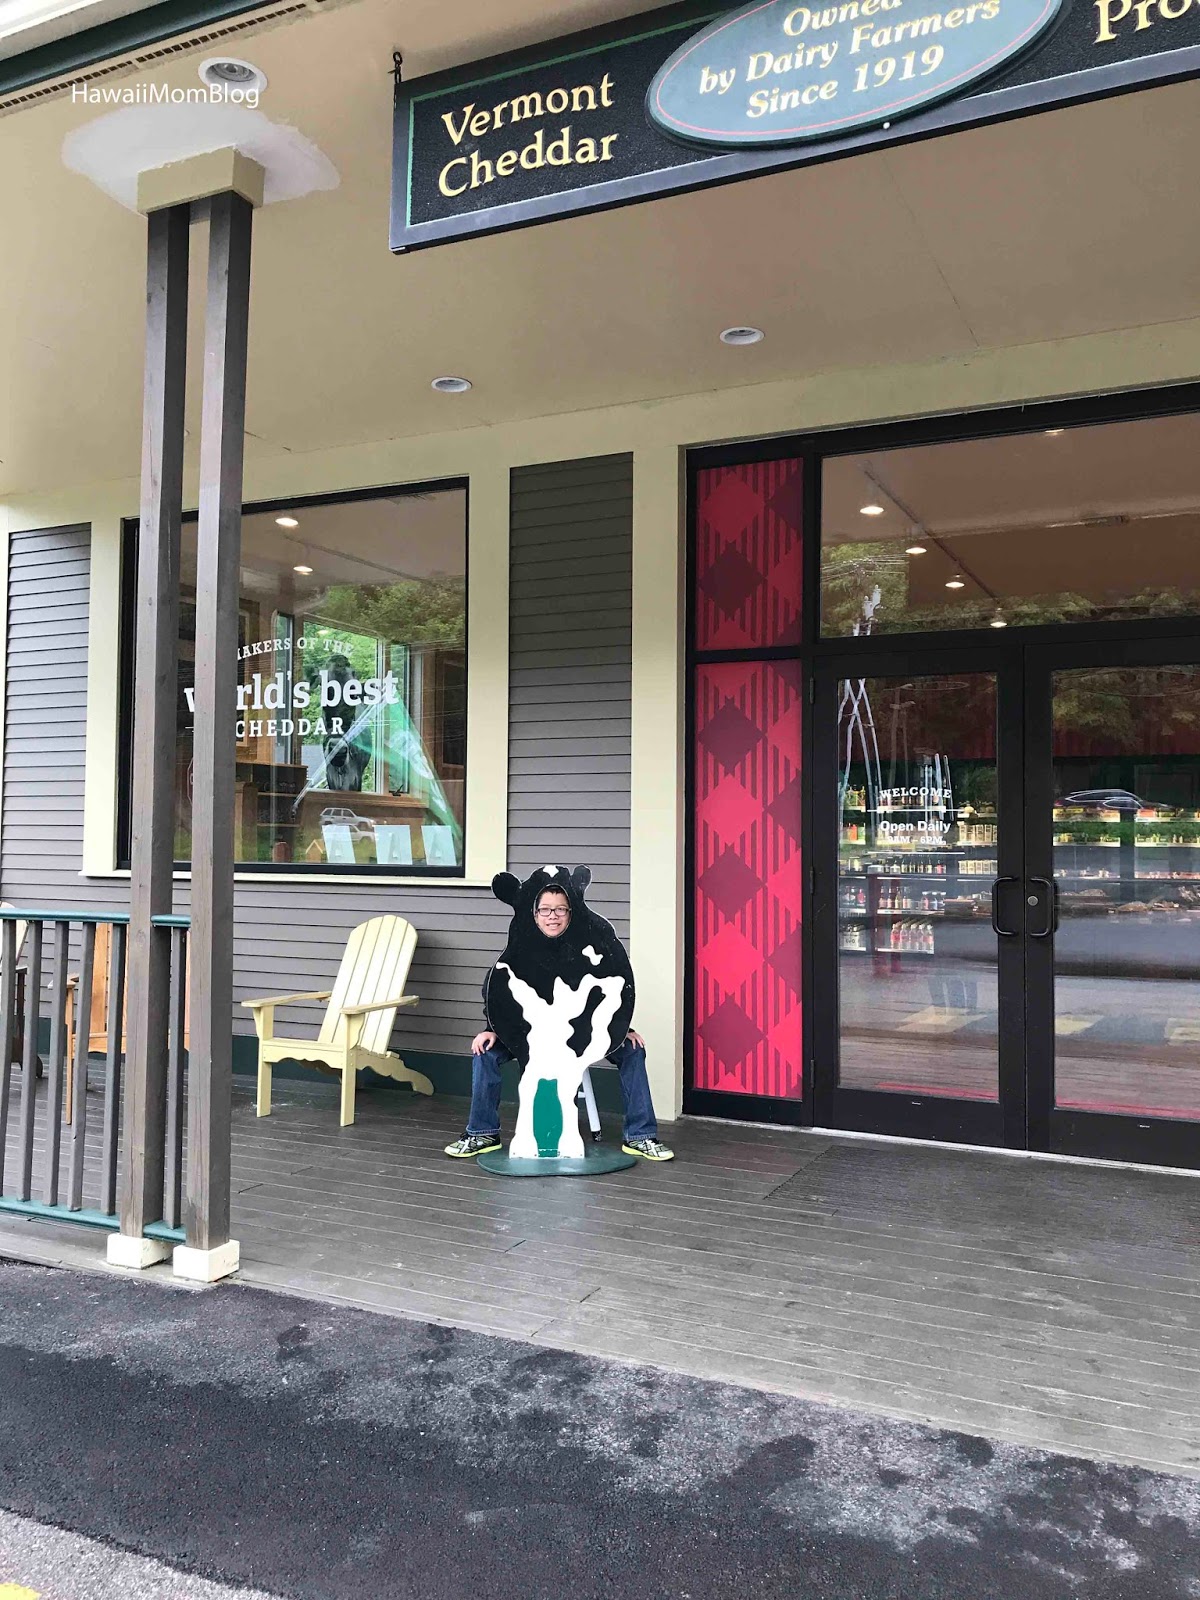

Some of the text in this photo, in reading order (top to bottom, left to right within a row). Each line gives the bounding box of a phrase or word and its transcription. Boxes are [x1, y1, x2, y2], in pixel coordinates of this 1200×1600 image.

[1092, 0, 1200, 44] Pro
[700, 0, 999, 95] by Dairy Farmers
[746, 44, 944, 118] Since 1919
[441, 73, 615, 146] Vermont
[438, 125, 619, 197] Cheddar
[297, 636, 319, 650] OF
[323, 638, 354, 657] THE
[184, 670, 399, 713] rld's best
[236, 716, 345, 738] CHEDDAR
[880, 786, 952, 799] WELCOME
[880, 820, 951, 833] Open Daily
